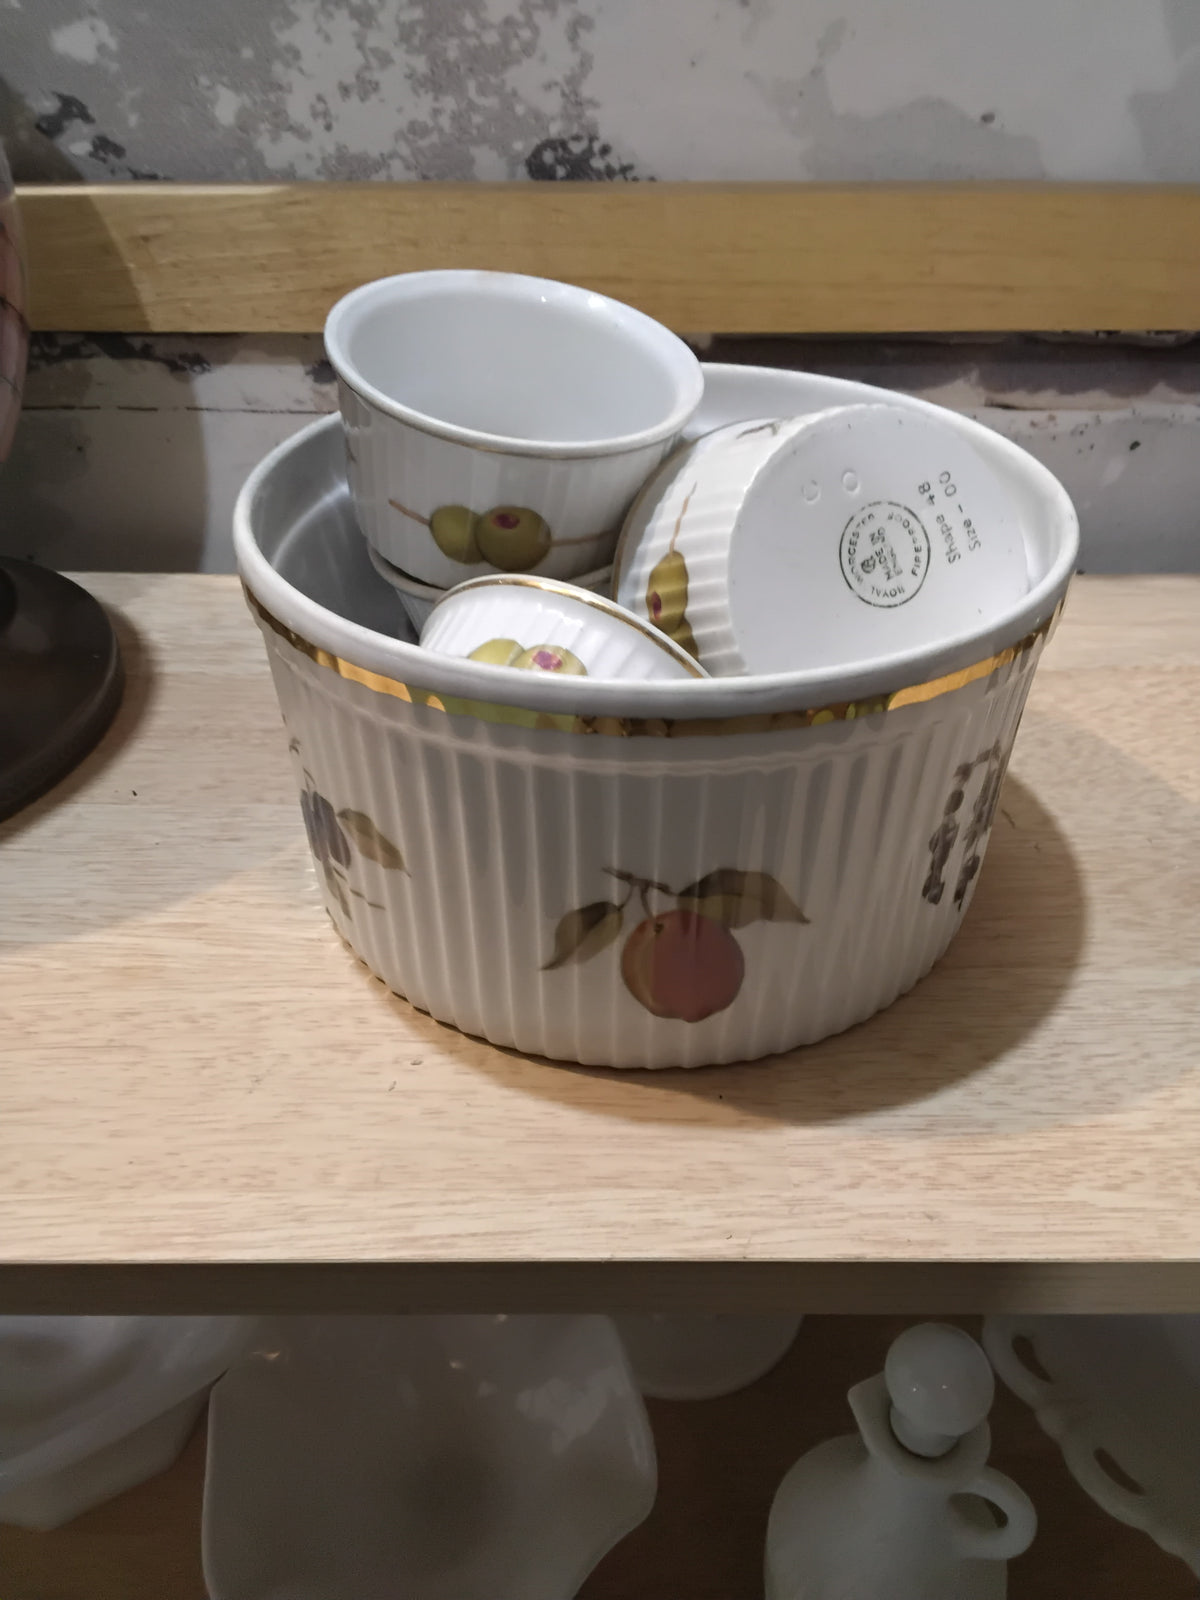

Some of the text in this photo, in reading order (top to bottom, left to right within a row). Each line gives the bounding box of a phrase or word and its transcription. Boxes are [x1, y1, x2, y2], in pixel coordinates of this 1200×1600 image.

[917, 481, 961, 564] Shape 48
[963, 518, 982, 552] Size
[870, 585, 906, 599] ROYAL
